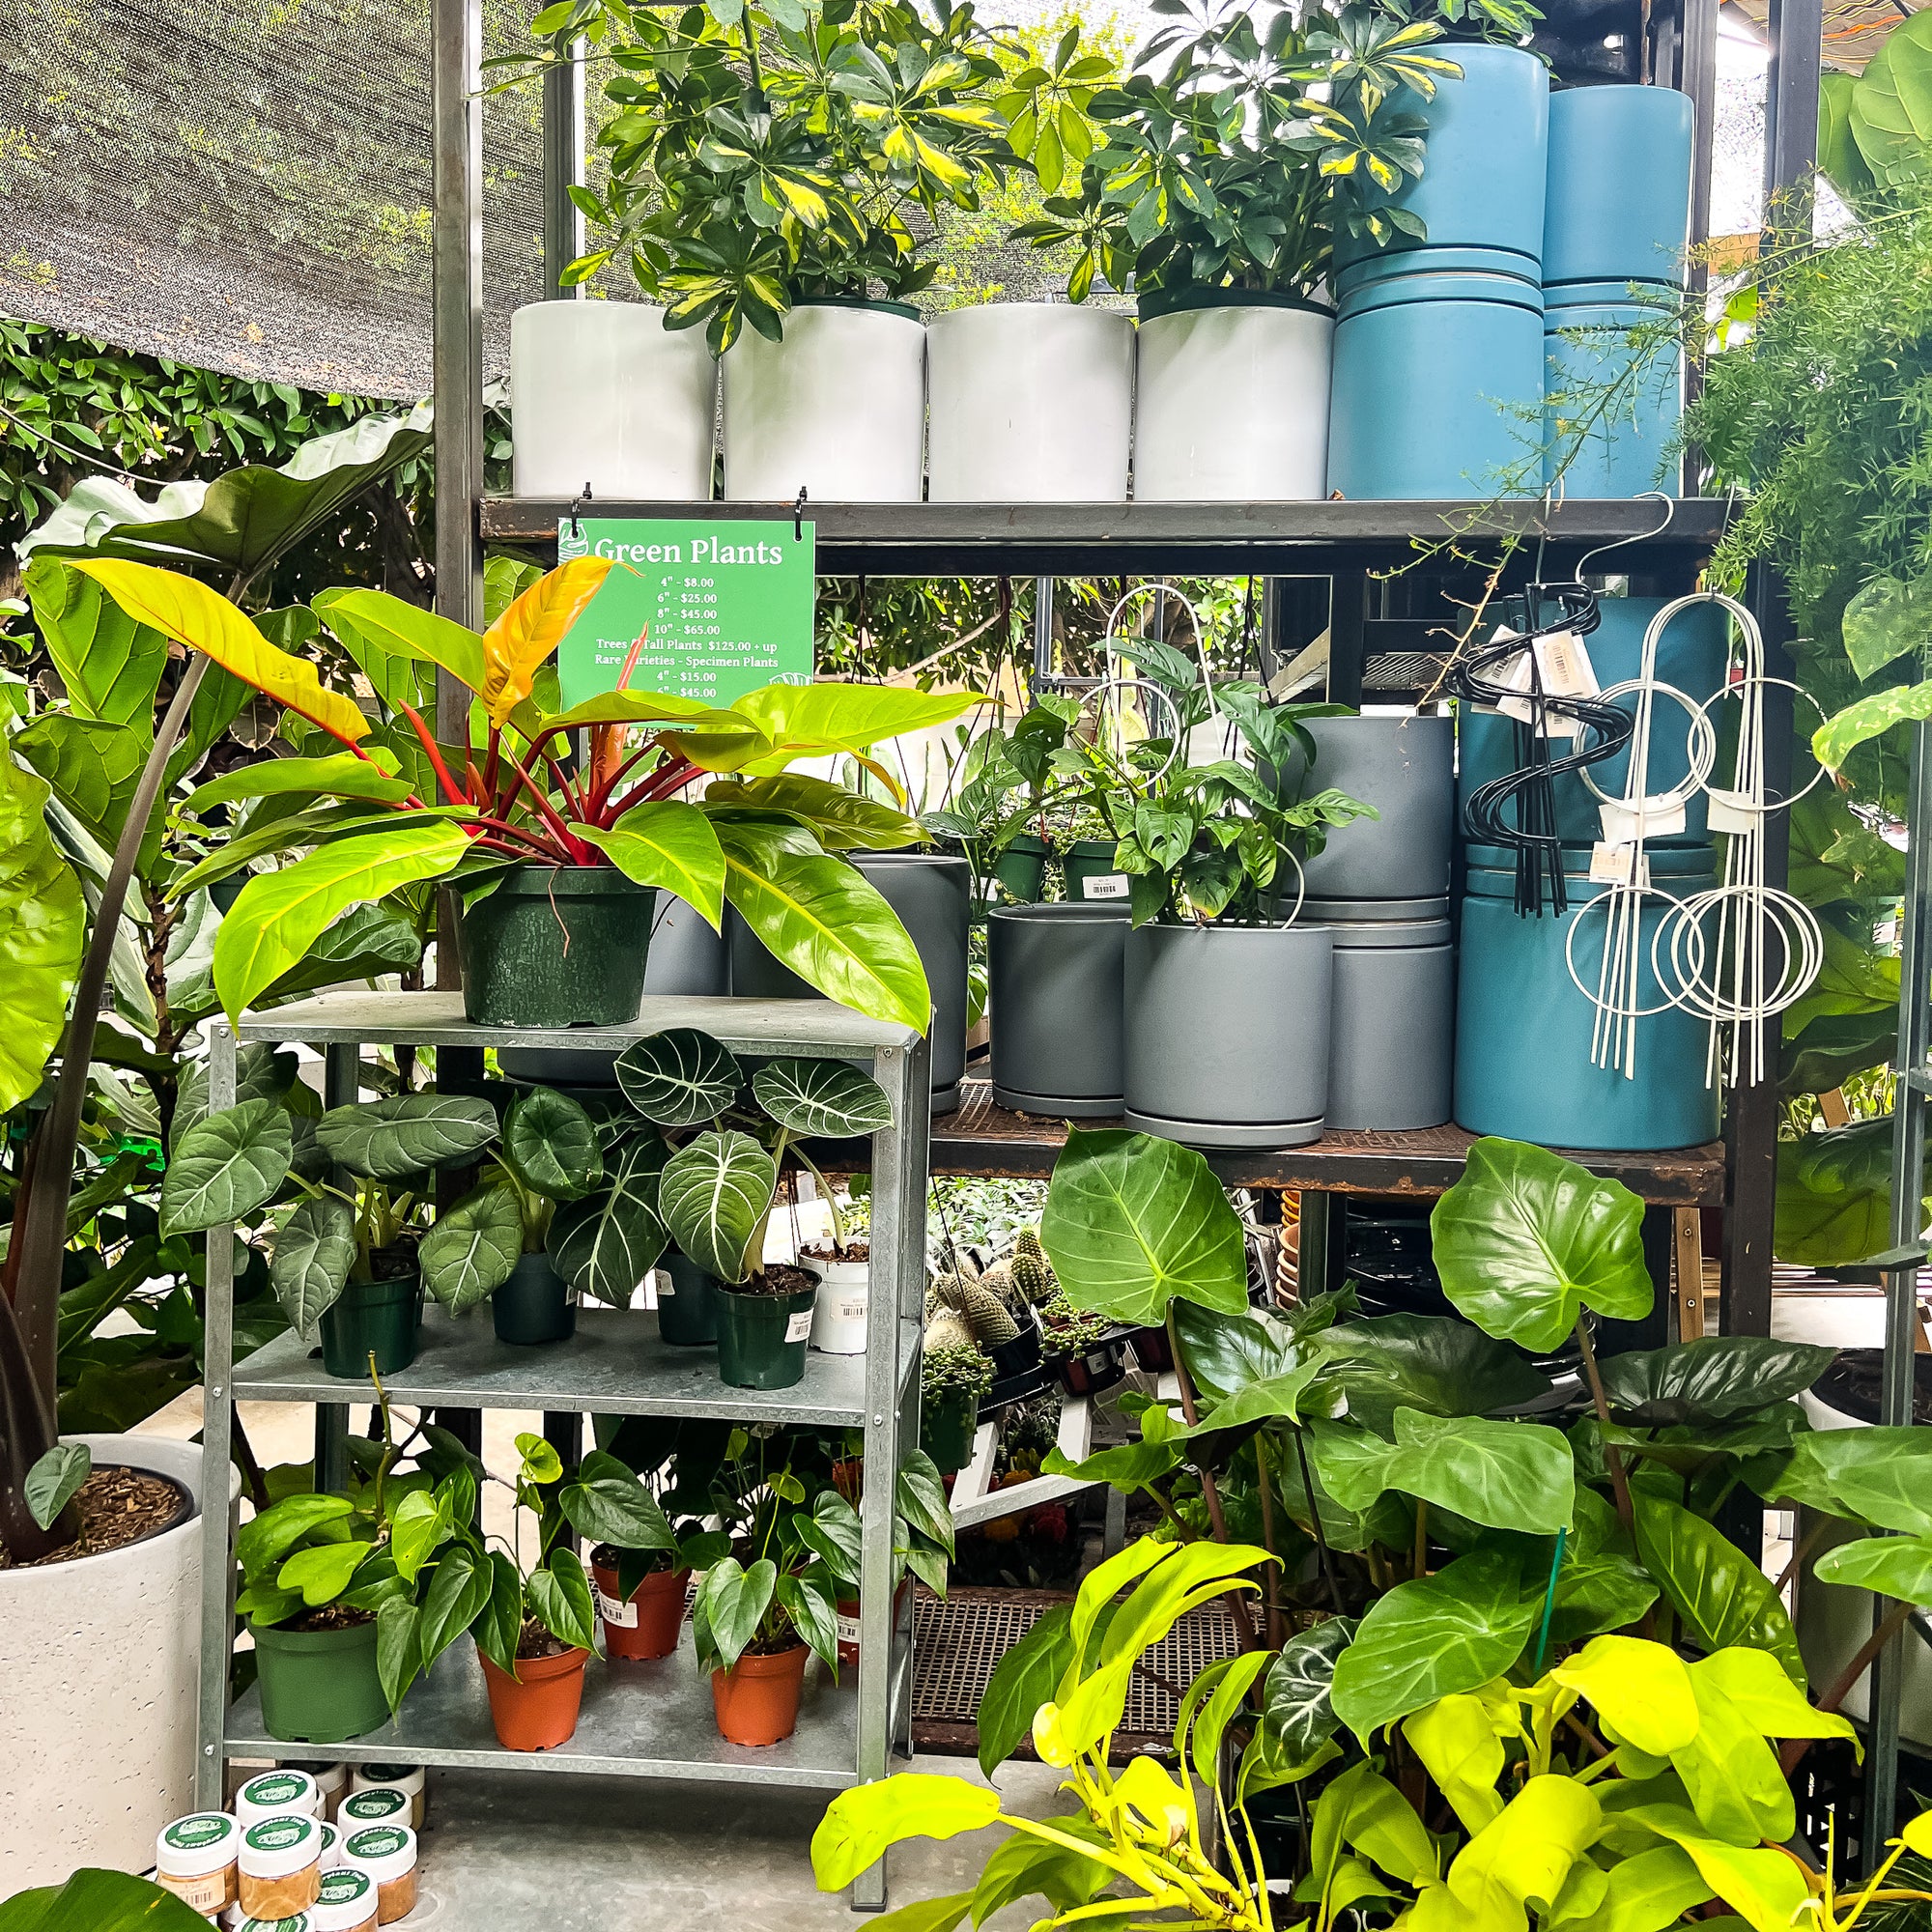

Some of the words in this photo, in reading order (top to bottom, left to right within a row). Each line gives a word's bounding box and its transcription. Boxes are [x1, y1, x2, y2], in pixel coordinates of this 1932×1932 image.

[594, 537, 682, 564] Green
[690, 535, 783, 565] Plants
[660, 576, 673, 587] 4"
[684, 577, 715, 588] $8.00
[657, 592, 670, 603] 6"
[680, 593, 718, 604] $25.00
[657, 608, 670, 619] 8"
[680, 609, 718, 619] $45.00
[654, 623, 673, 635] 10"
[684, 624, 721, 635] $65.00
[595, 639, 628, 649] Trees
[642, 639, 664, 650] Tall
[667, 639, 702, 651] Plants
[708, 641, 752, 652] $125.00
[762, 643, 778, 654] up
[595, 654, 621, 665] Rare
[624, 654, 675, 666] arieties
[686, 656, 740, 669] Specimen
[743, 656, 779, 668] Plants
[656, 670, 669, 681] 4"
[680, 671, 717, 682] $15.00
[680, 688, 717, 698] $45.00
